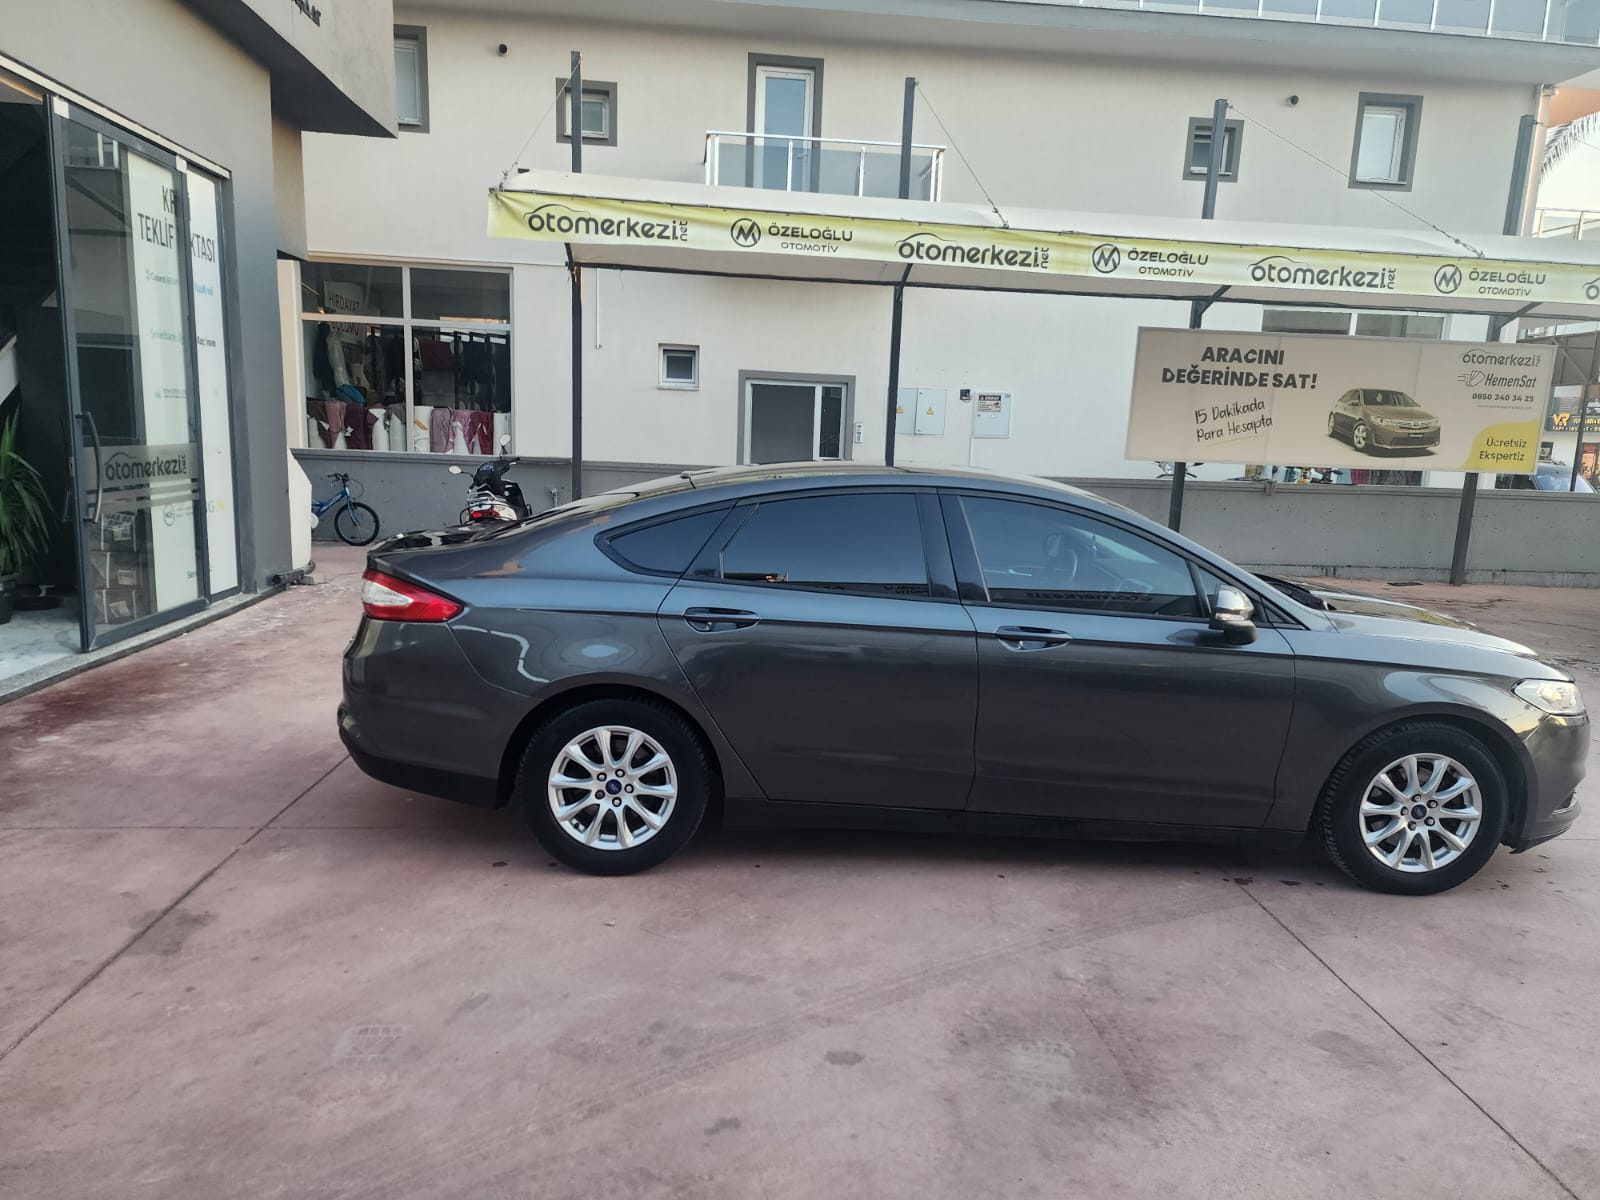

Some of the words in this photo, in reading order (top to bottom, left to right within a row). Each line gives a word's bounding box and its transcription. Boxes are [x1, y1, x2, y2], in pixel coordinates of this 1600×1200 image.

[138, 212, 174, 249] TEKLİF
[191, 232, 216, 263] KTASI
[768, 222, 853, 241] ÖZELOĞLU
[781, 242, 839, 253] OTOMOTİV
[1127, 248, 1209, 266] ÖZELOĞLU
[1138, 266, 1195, 277] OTOMOTİV
[1468, 267, 1546, 285] ÖZELOĞLU
[1478, 286, 1532, 297] OTOMOTİV
[1201, 346, 1285, 366] ARACINI
[1462, 353, 1536, 367] otomerkezi
[1161, 364, 1269, 388] DEĞERİNDE
[1271, 372, 1318, 390] SAT!
[1484, 373, 1537, 388] HemenSat
[1195, 408, 1208, 424] 15
[1212, 397, 1265, 421] Dakikada
[1196, 428, 1224, 442] Para
[1228, 414, 1273, 436] Hesapta
[1486, 436, 1527, 449] Ücretsiz
[1479, 450, 1525, 463] Ekspertiz
[105, 455, 182, 480] otomerkezi
